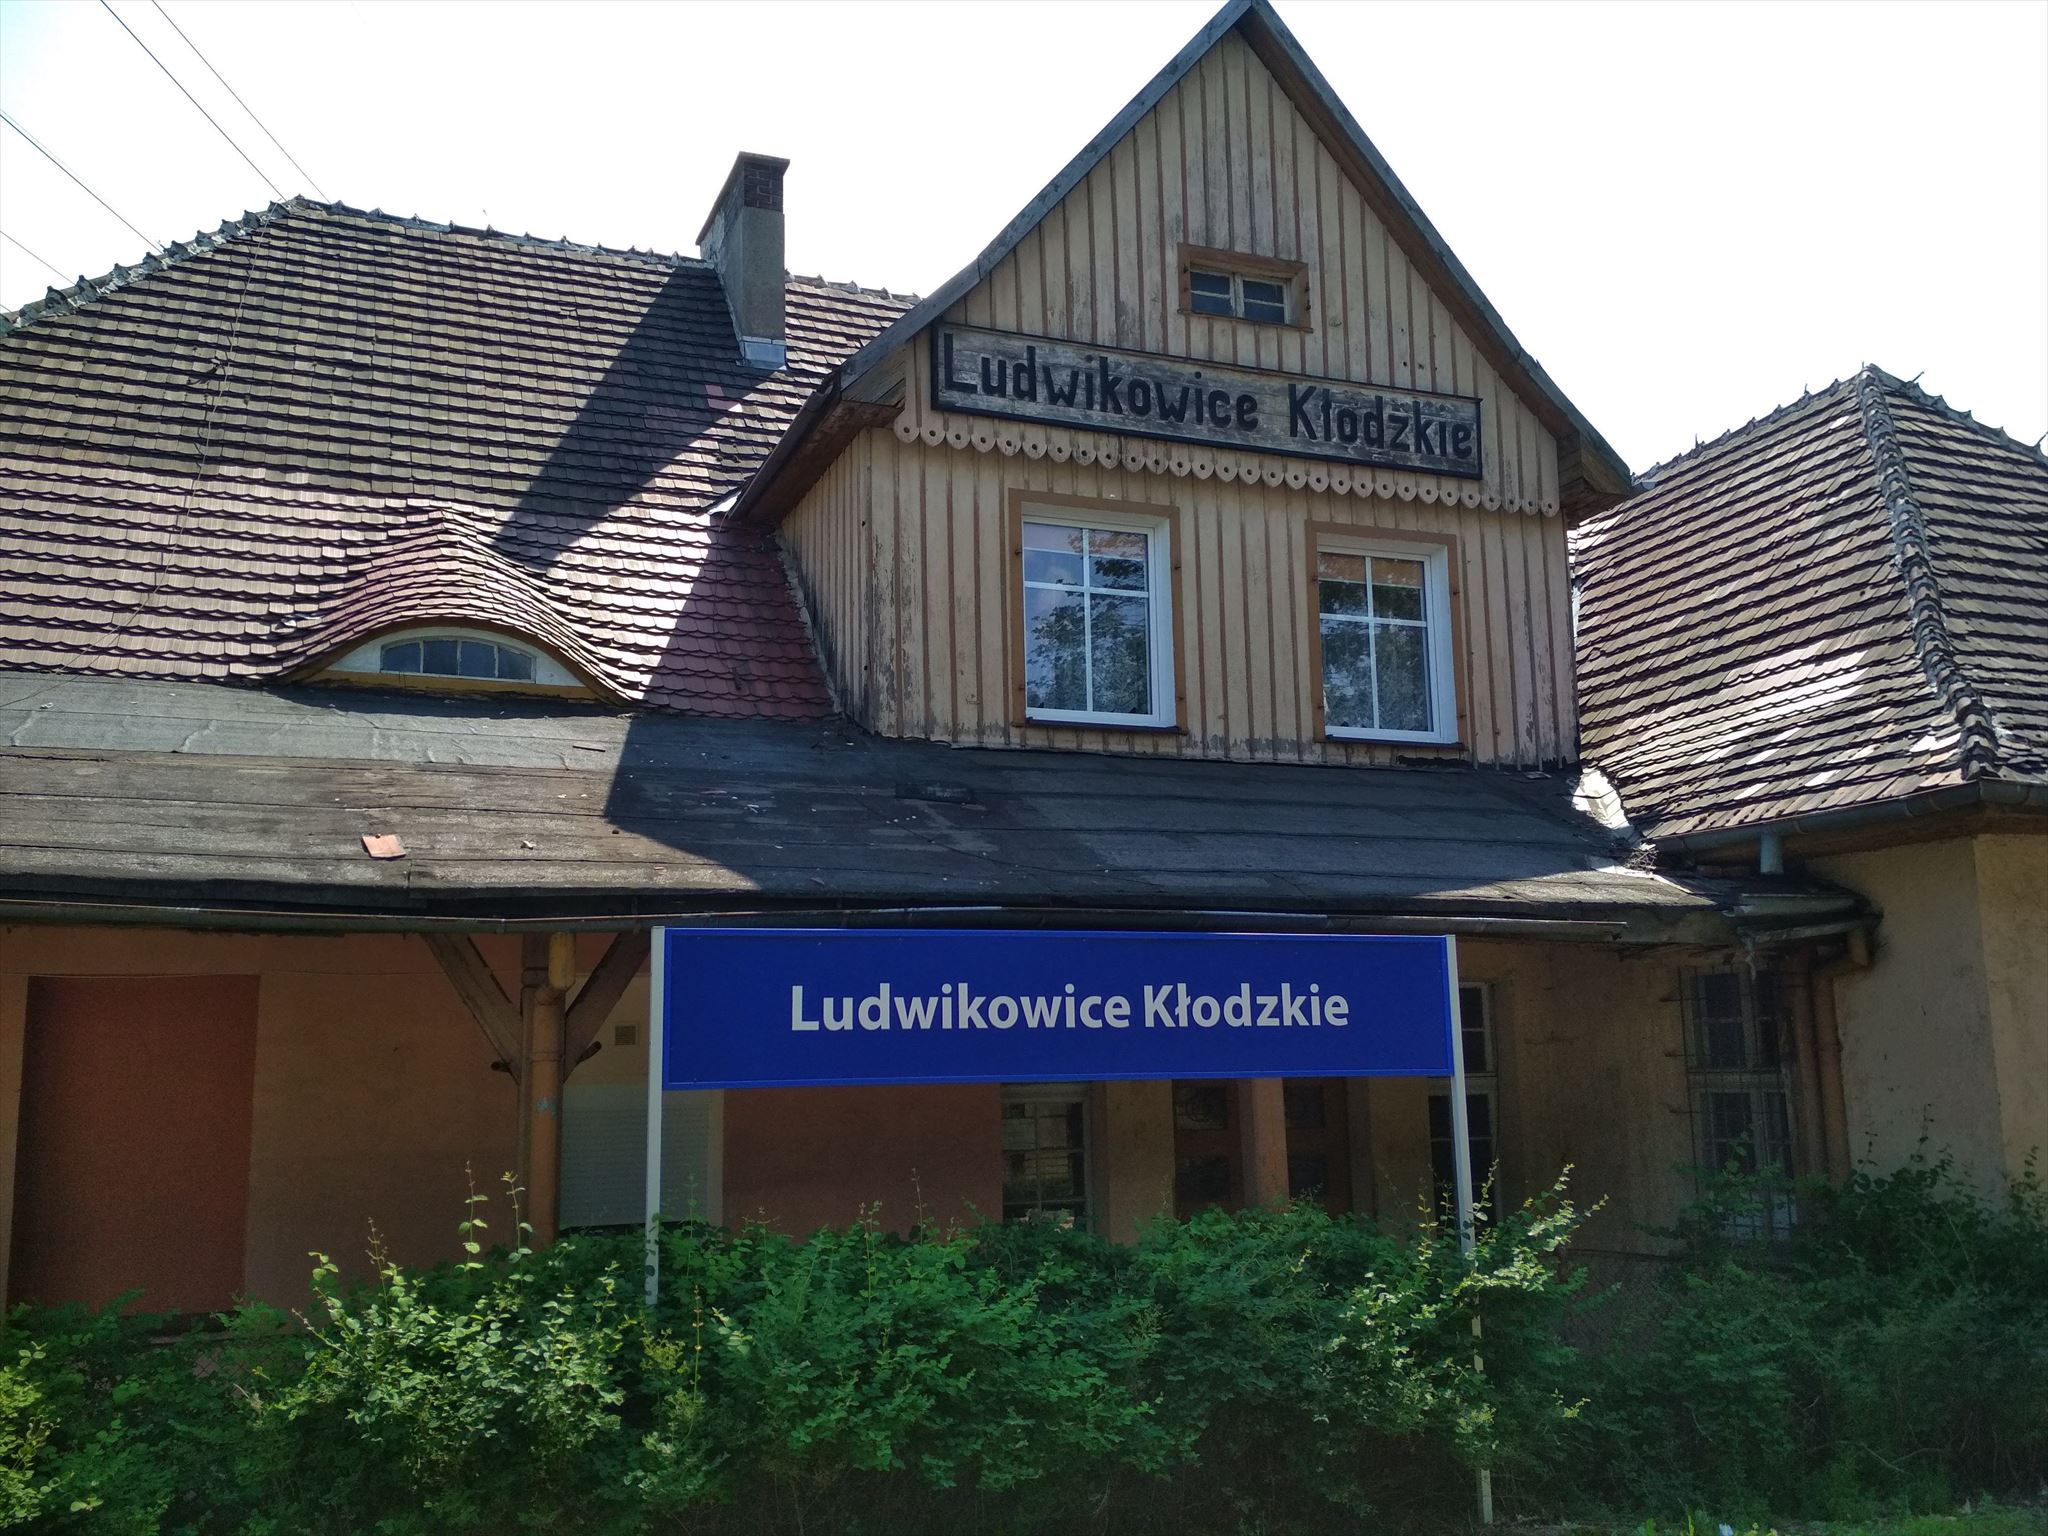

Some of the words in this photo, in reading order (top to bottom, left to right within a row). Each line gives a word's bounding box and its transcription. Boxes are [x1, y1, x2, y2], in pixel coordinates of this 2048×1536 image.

[943, 333, 1259, 431] Ludwikowice
[1287, 383, 1474, 459] Kłodzkie
[791, 982, 1131, 1031] Ludwikowice
[1143, 982, 1350, 1029] Kłodzkie
